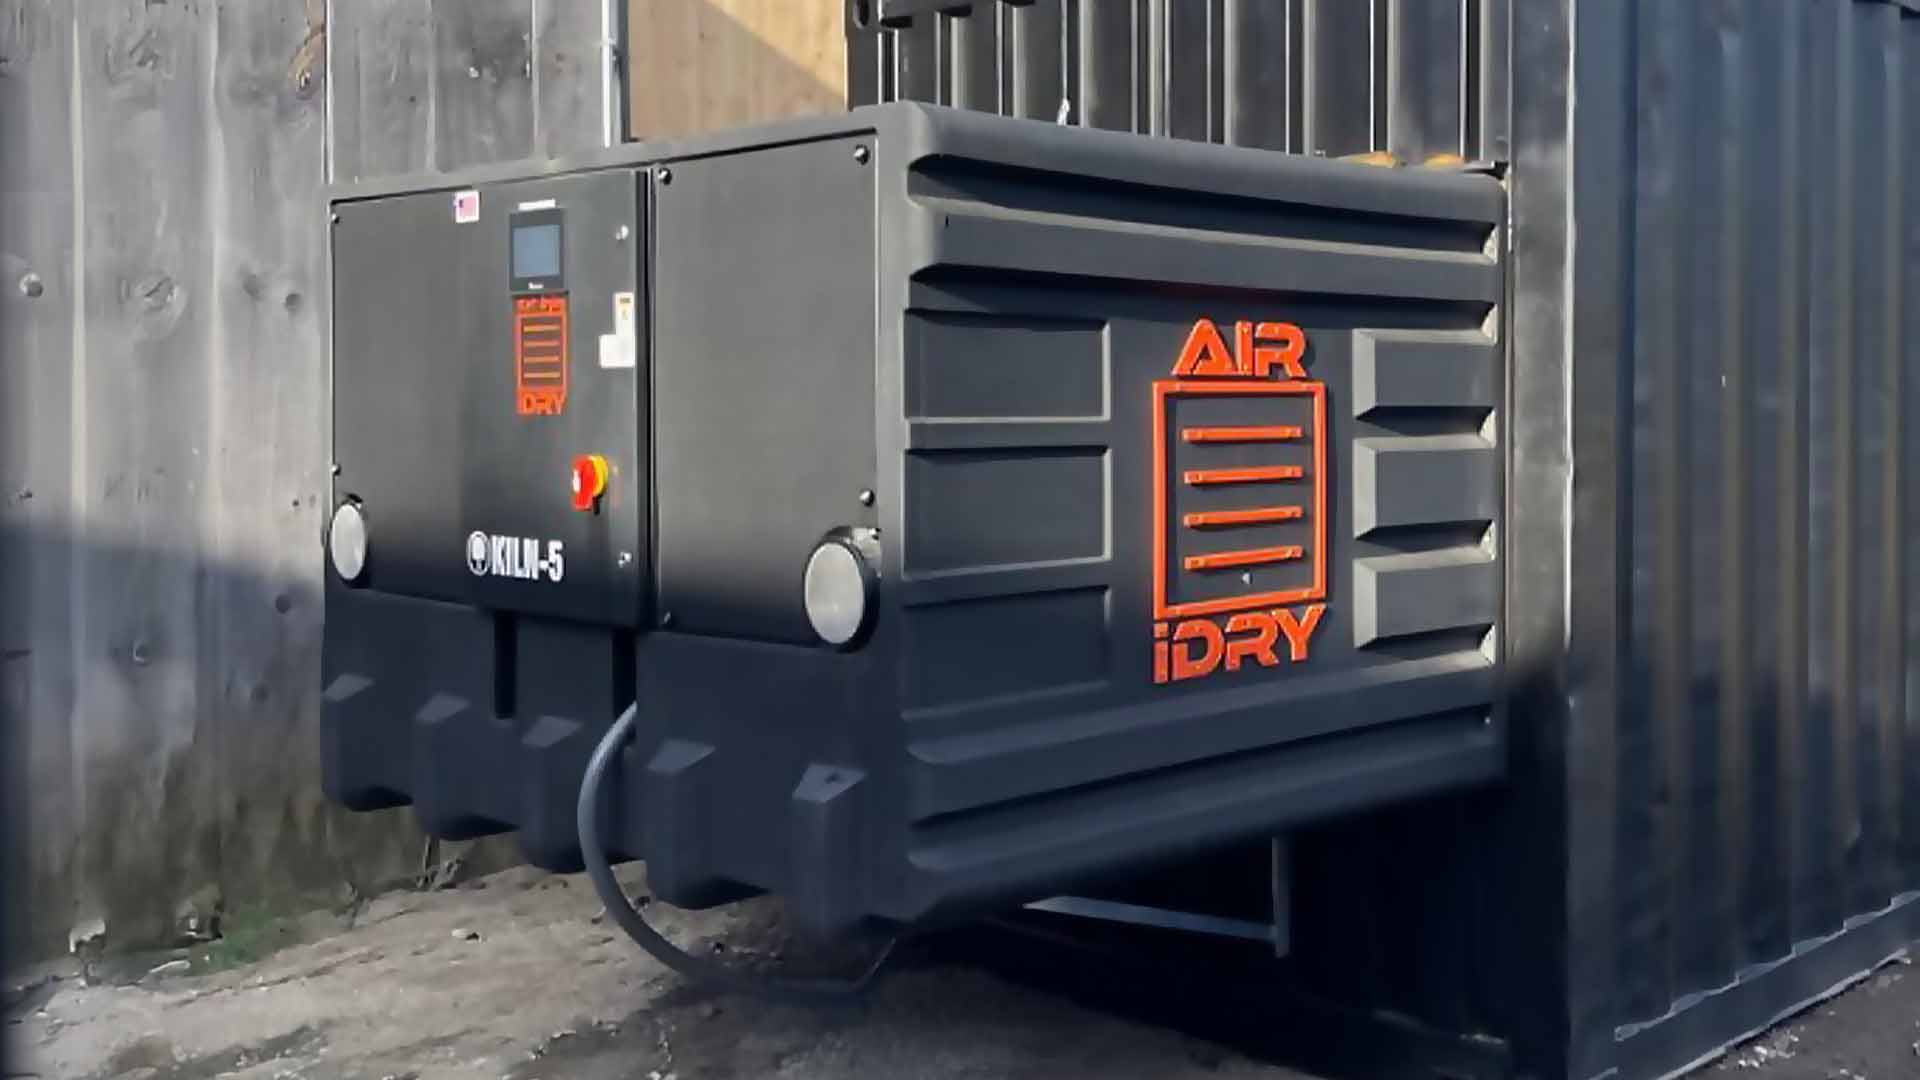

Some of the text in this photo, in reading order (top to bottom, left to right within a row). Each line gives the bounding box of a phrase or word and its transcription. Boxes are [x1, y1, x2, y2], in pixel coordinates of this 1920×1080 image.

[1171, 318, 1307, 377] AIR
[491, 534, 565, 582] KILN-5
[1154, 603, 1327, 683] iDRY
